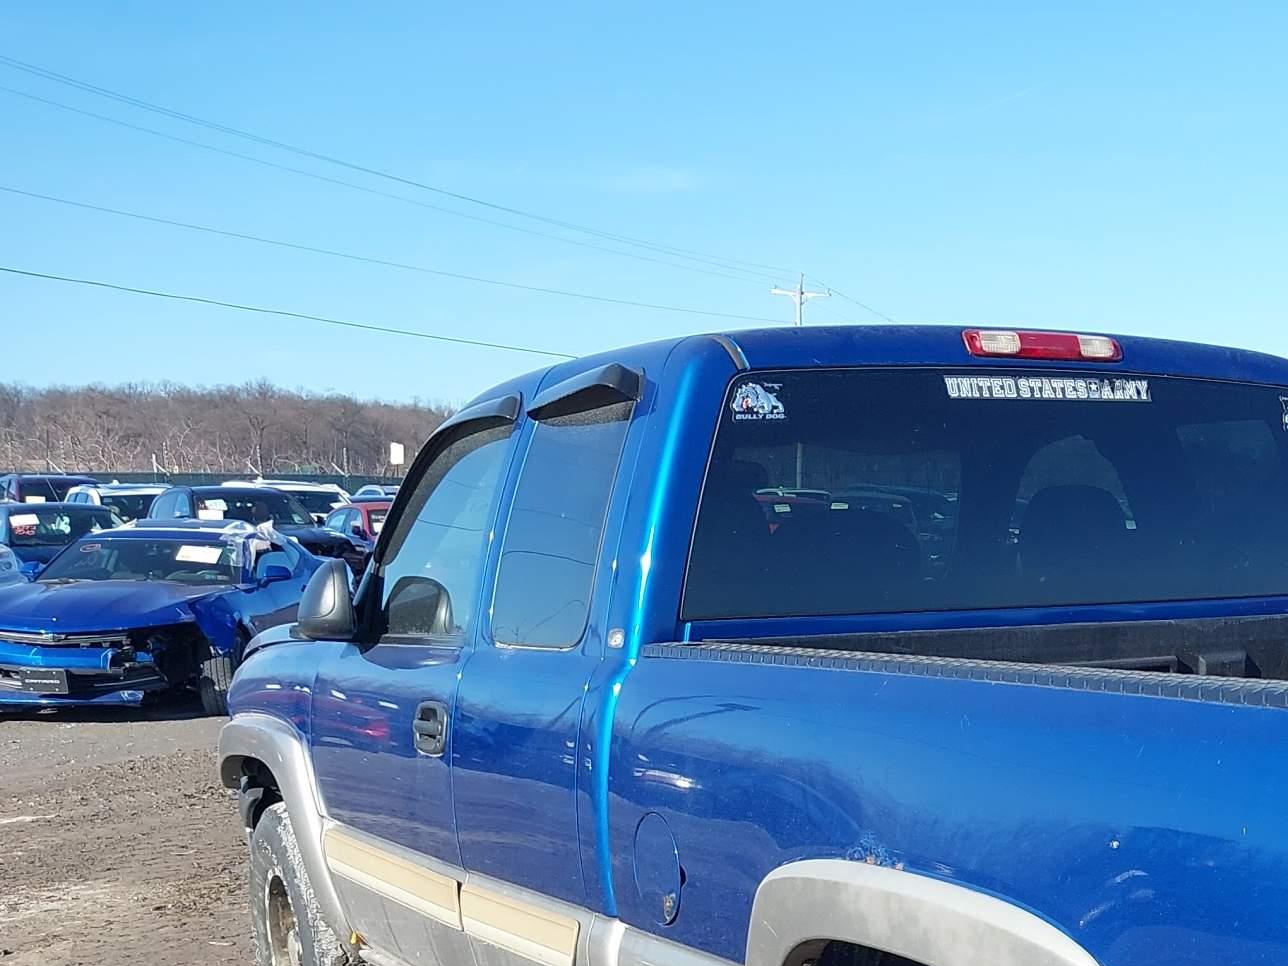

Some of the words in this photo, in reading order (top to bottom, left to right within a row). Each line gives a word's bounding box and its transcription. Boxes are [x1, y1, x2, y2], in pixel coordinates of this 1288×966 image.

[945, 377, 1016, 398] UNITED
[1019, 378, 1088, 399] STATES
[1101, 379, 1149, 399] ARMY
